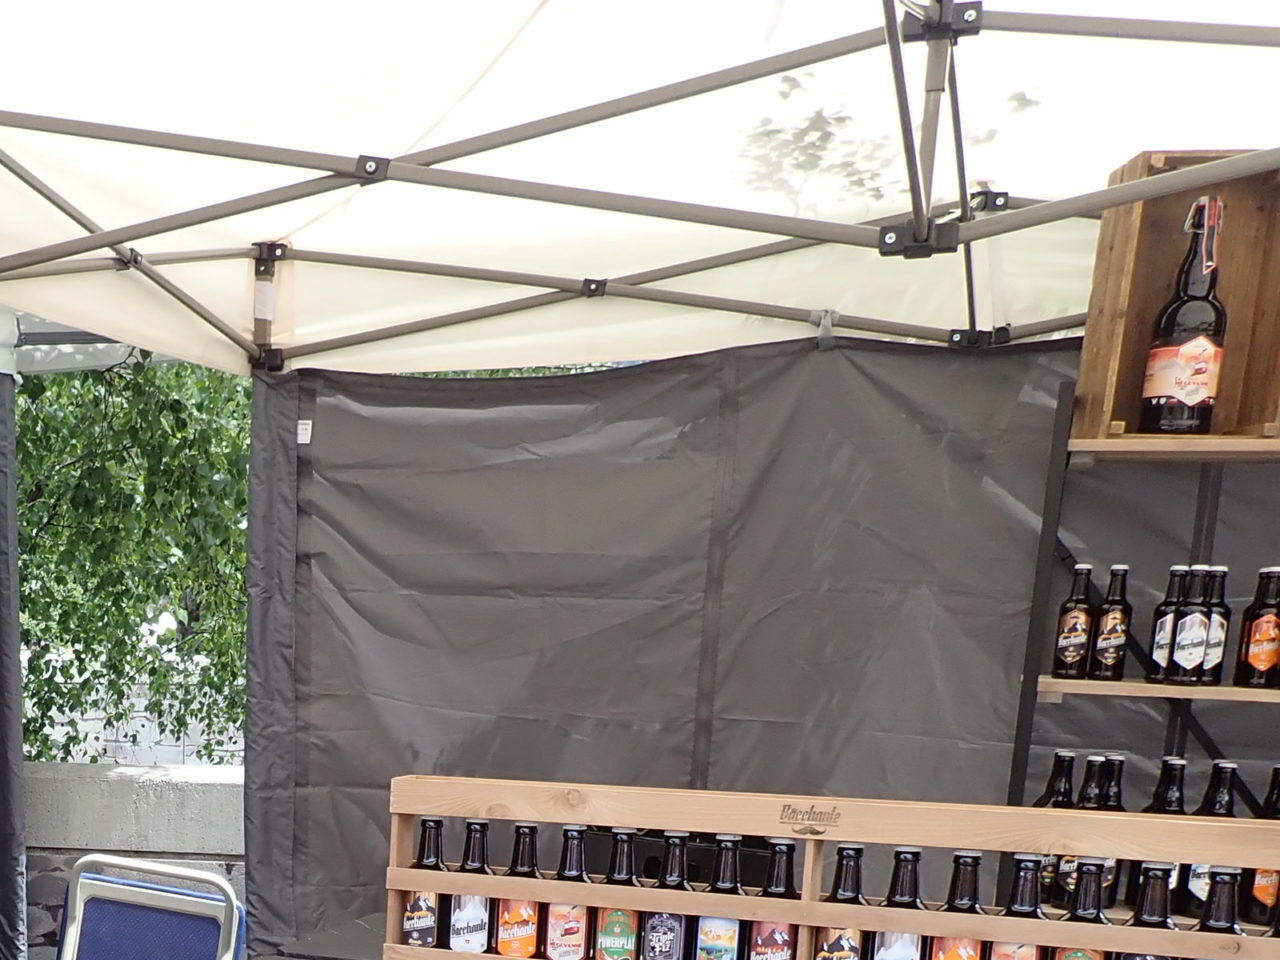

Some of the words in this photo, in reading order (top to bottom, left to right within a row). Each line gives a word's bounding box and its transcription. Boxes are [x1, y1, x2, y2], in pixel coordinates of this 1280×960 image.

[779, 804, 841, 823] Bacchante
[451, 918, 487, 936] Bacchante
[499, 921, 536, 939] Bacchante
